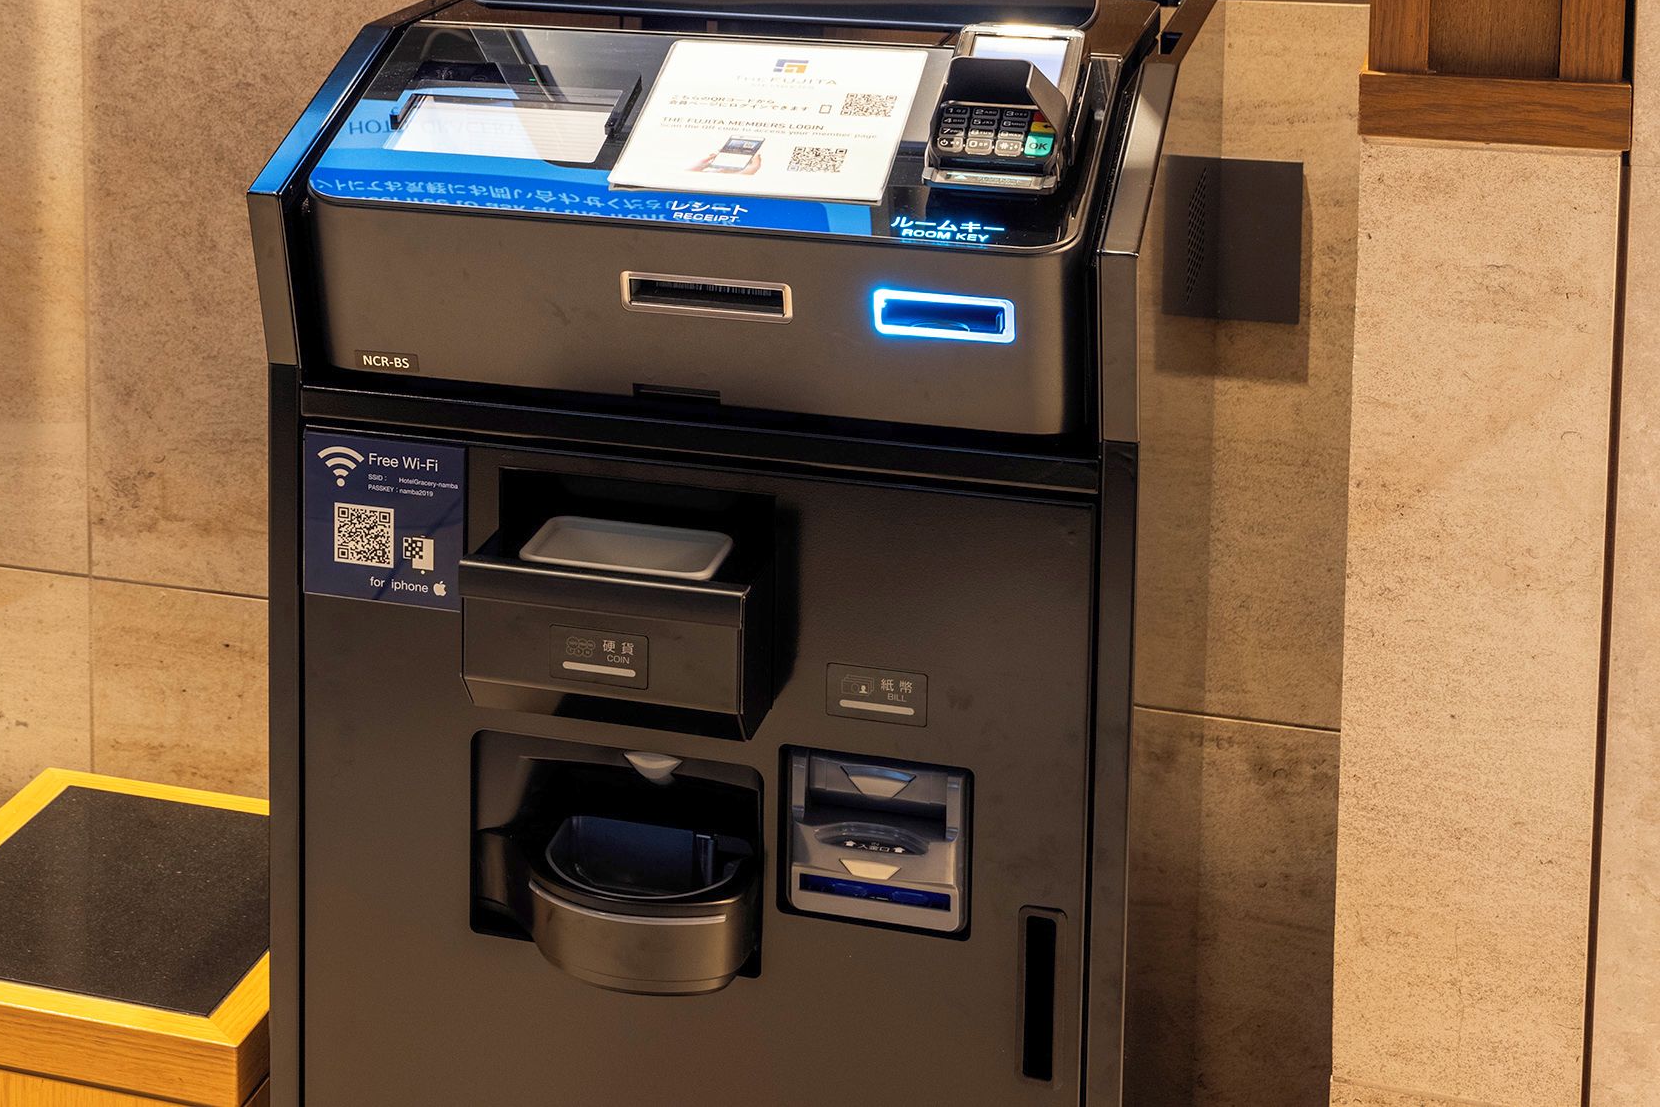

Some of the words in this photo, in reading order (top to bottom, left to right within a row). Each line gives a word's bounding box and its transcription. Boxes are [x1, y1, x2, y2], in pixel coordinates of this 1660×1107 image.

[662, 116, 683, 124] THE
[686, 118, 726, 126] FUJITA
[728, 120, 786, 130] MEMBERS
[1029, 143, 1048, 151] OK
[671, 200, 749, 216] レシート
[672, 212, 740, 223] RECEIPT
[890, 216, 1005, 232] ルームキー
[901, 229, 951, 240] ROOM
[955, 233, 989, 243] KEY
[362, 355, 410, 369] NCR-BS
[368, 452, 399, 468] Free
[402, 456, 439, 472] Wi-Fi
[367, 483, 395, 493] PASSKEY
[399, 488, 434, 498] namba2019
[398, 477, 459, 490] HotelGracery-namba
[369, 576, 385, 588] for
[391, 578, 429, 593] iphone
[606, 654, 630, 665] COIN
[887, 693, 908, 703] BILL
